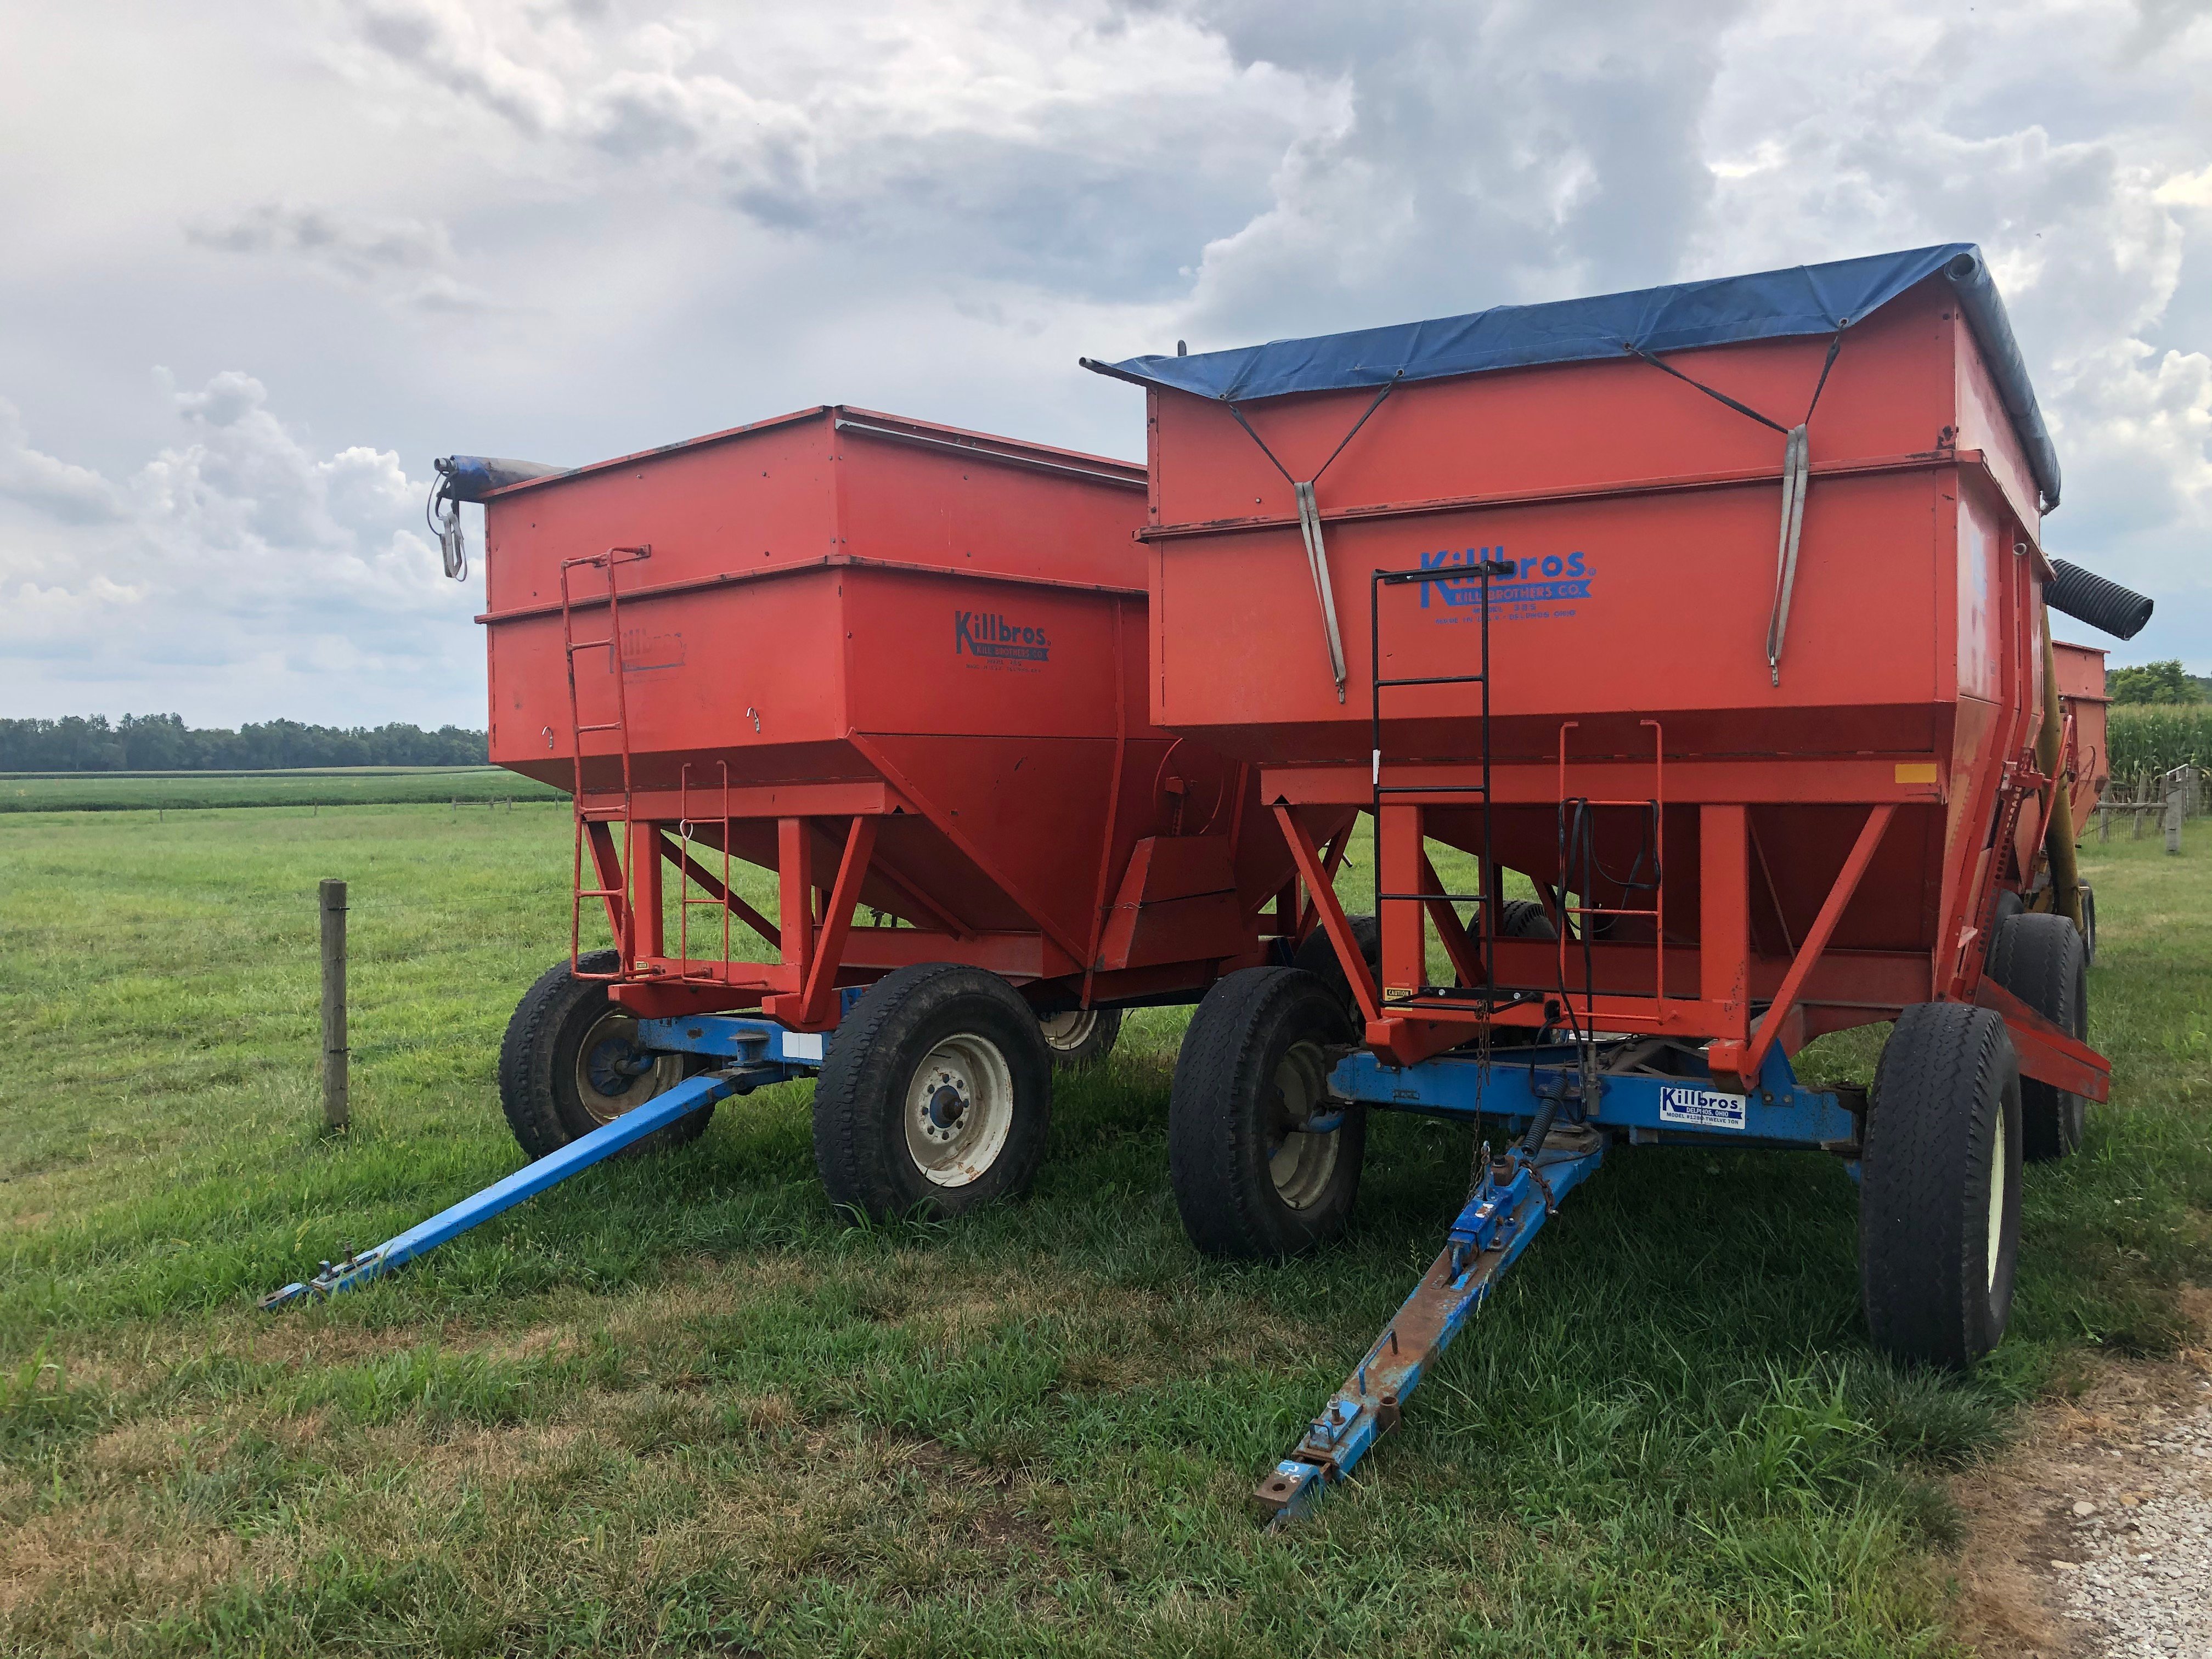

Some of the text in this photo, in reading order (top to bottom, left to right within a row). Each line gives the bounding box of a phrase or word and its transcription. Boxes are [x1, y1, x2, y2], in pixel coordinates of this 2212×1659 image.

[1420, 546, 1585, 608] Killbros
[1455, 592, 1482, 603] KILL
[1487, 586, 1553, 600] BROTHERS
[955, 611, 1046, 654] Killbros
[1662, 1088, 1739, 1111] Killbros
